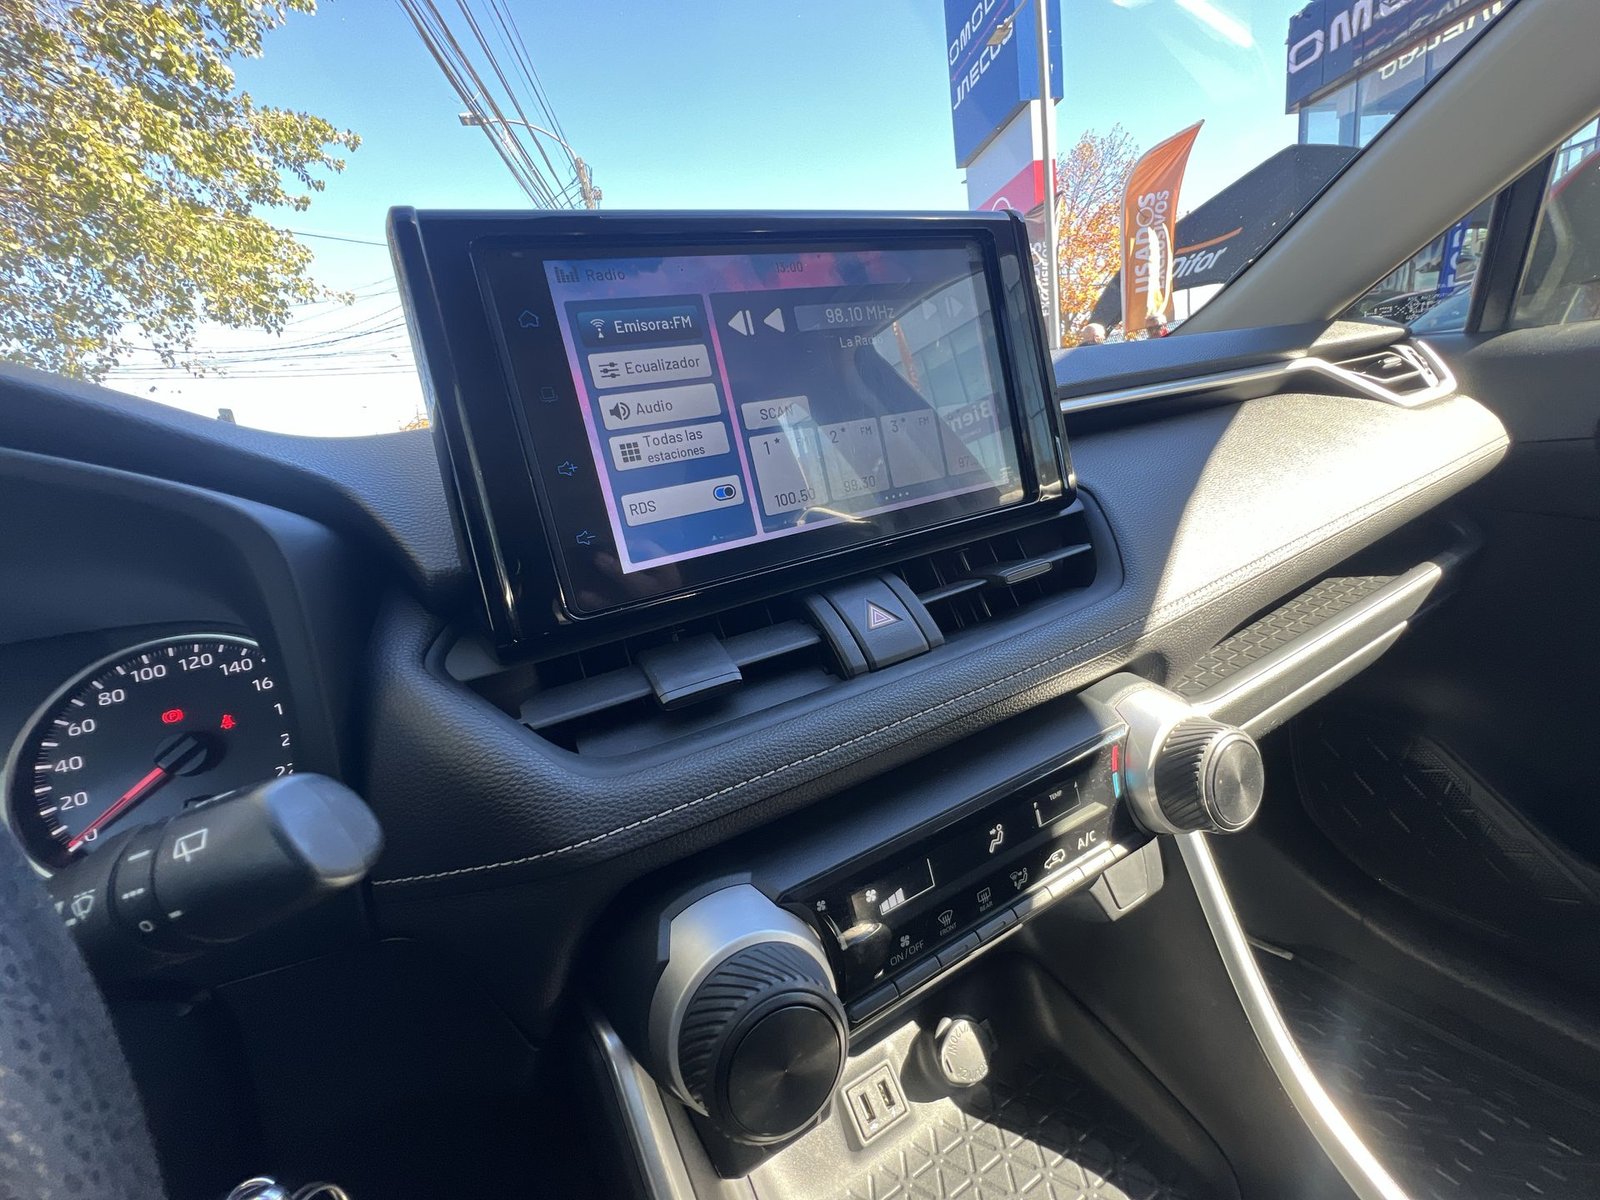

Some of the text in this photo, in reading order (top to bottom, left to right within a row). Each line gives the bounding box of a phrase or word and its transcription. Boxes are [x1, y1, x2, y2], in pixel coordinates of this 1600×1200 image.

[586, 268, 625, 282] Radio
[776, 261, 804, 273] 13:00
[825, 304, 896, 323] 98.10 MHz
[613, 315, 693, 334] Emisora:FM
[839, 336, 853, 348] La
[624, 356, 701, 375] Ecualizador
[636, 400, 673, 416] Audio
[759, 403, 794, 420] SCAN
[918, 416, 930, 426] FM
[643, 429, 703, 448] Todas las
[860, 426, 873, 436] FM
[647, 445, 706, 463] estaciones
[843, 475, 876, 493] 99.30
[774, 487, 816, 507] 100.50
[629, 501, 657, 516] RDS
[178, 653, 214, 671] 120
[219, 657, 253, 676] 140
[130, 664, 167, 684] 100
[98, 688, 125, 706] 80
[68, 718, 96, 736] 60
[54, 755, 83, 773] 40
[60, 791, 88, 811] 20
[1077, 830, 1097, 850] A/C
[939, 921, 957, 937] FRONT
[890, 940, 924, 966] ON/OFF
